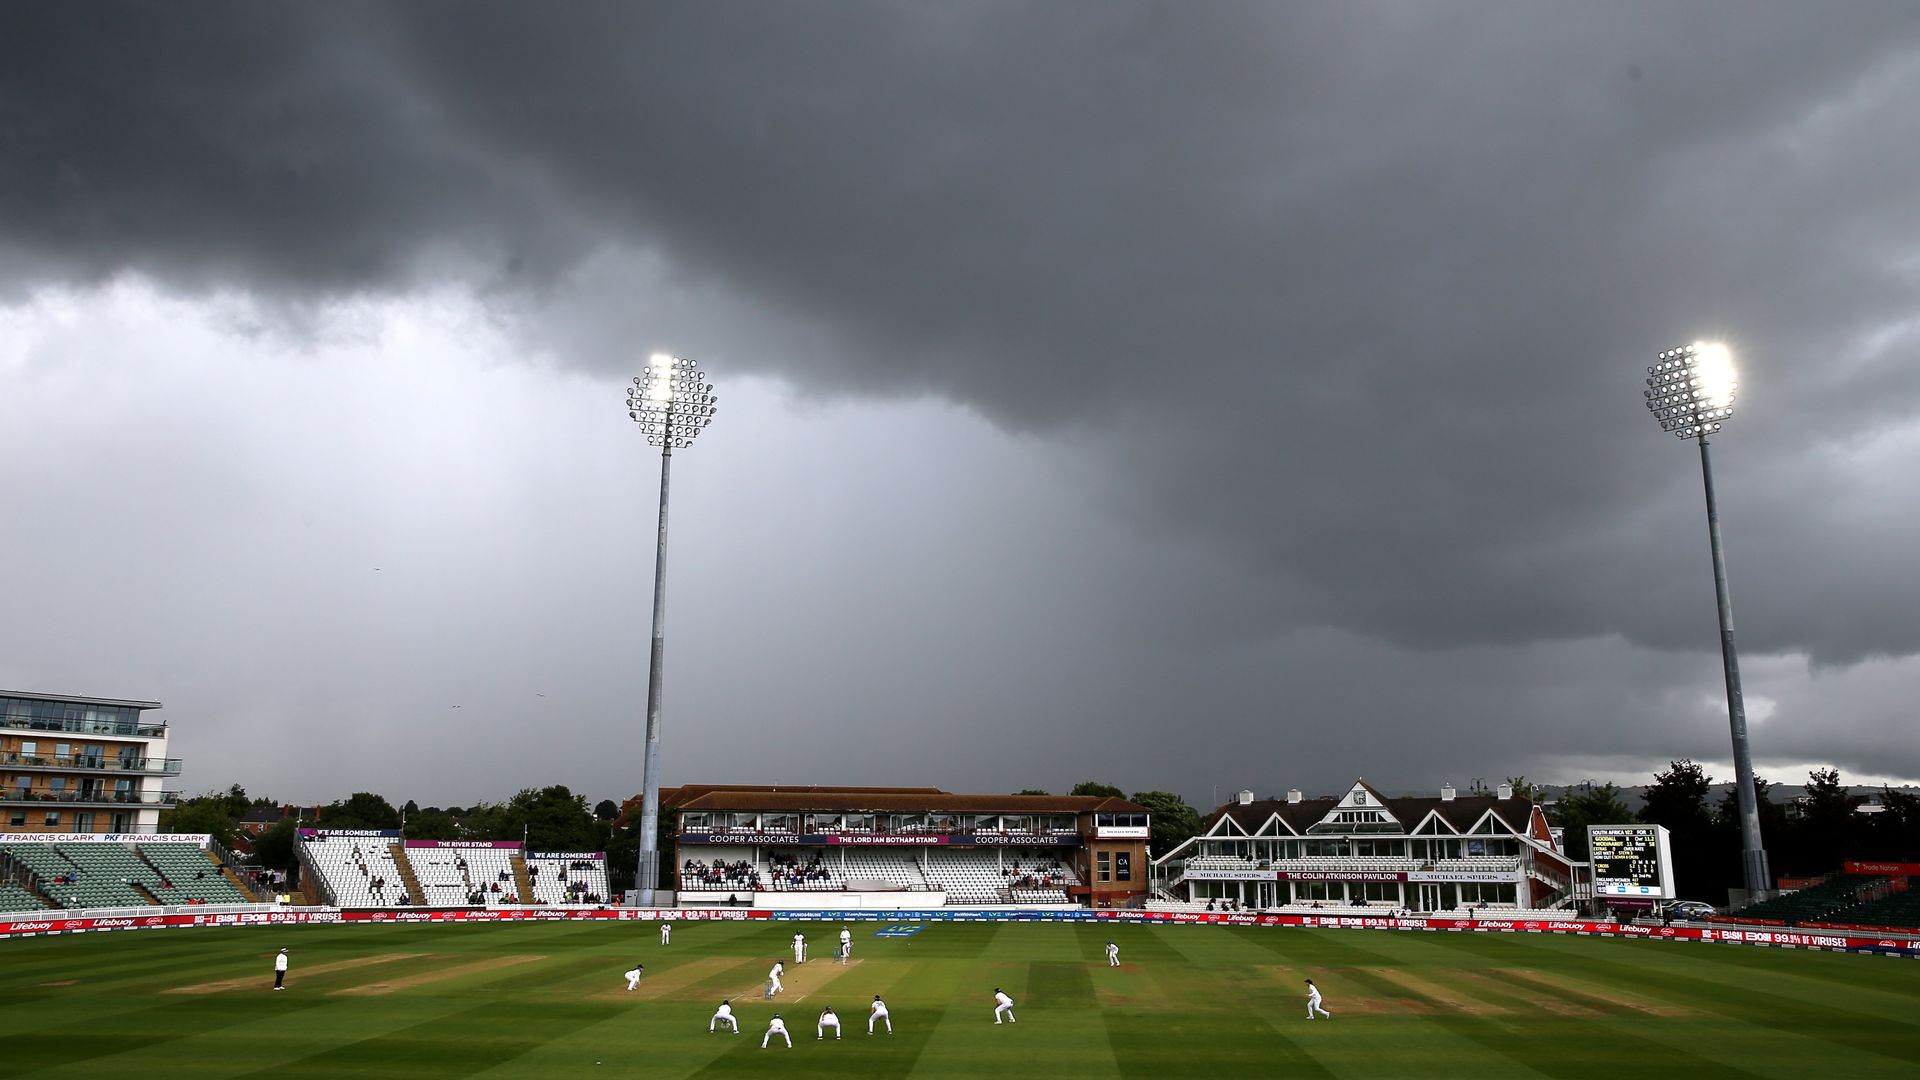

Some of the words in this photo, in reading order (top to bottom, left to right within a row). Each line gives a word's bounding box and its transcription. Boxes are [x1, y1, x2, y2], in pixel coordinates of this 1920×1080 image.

[10, 922, 54, 930] Lifebuoy
[1397, 919, 1427, 927] VIRUSES
[1549, 922, 1585, 930] Lifebuoy
[1619, 925, 1651, 934] Lifebuoy
[1802, 936, 1809, 944] OF
[1811, 936, 1847, 947] VIRUSES
